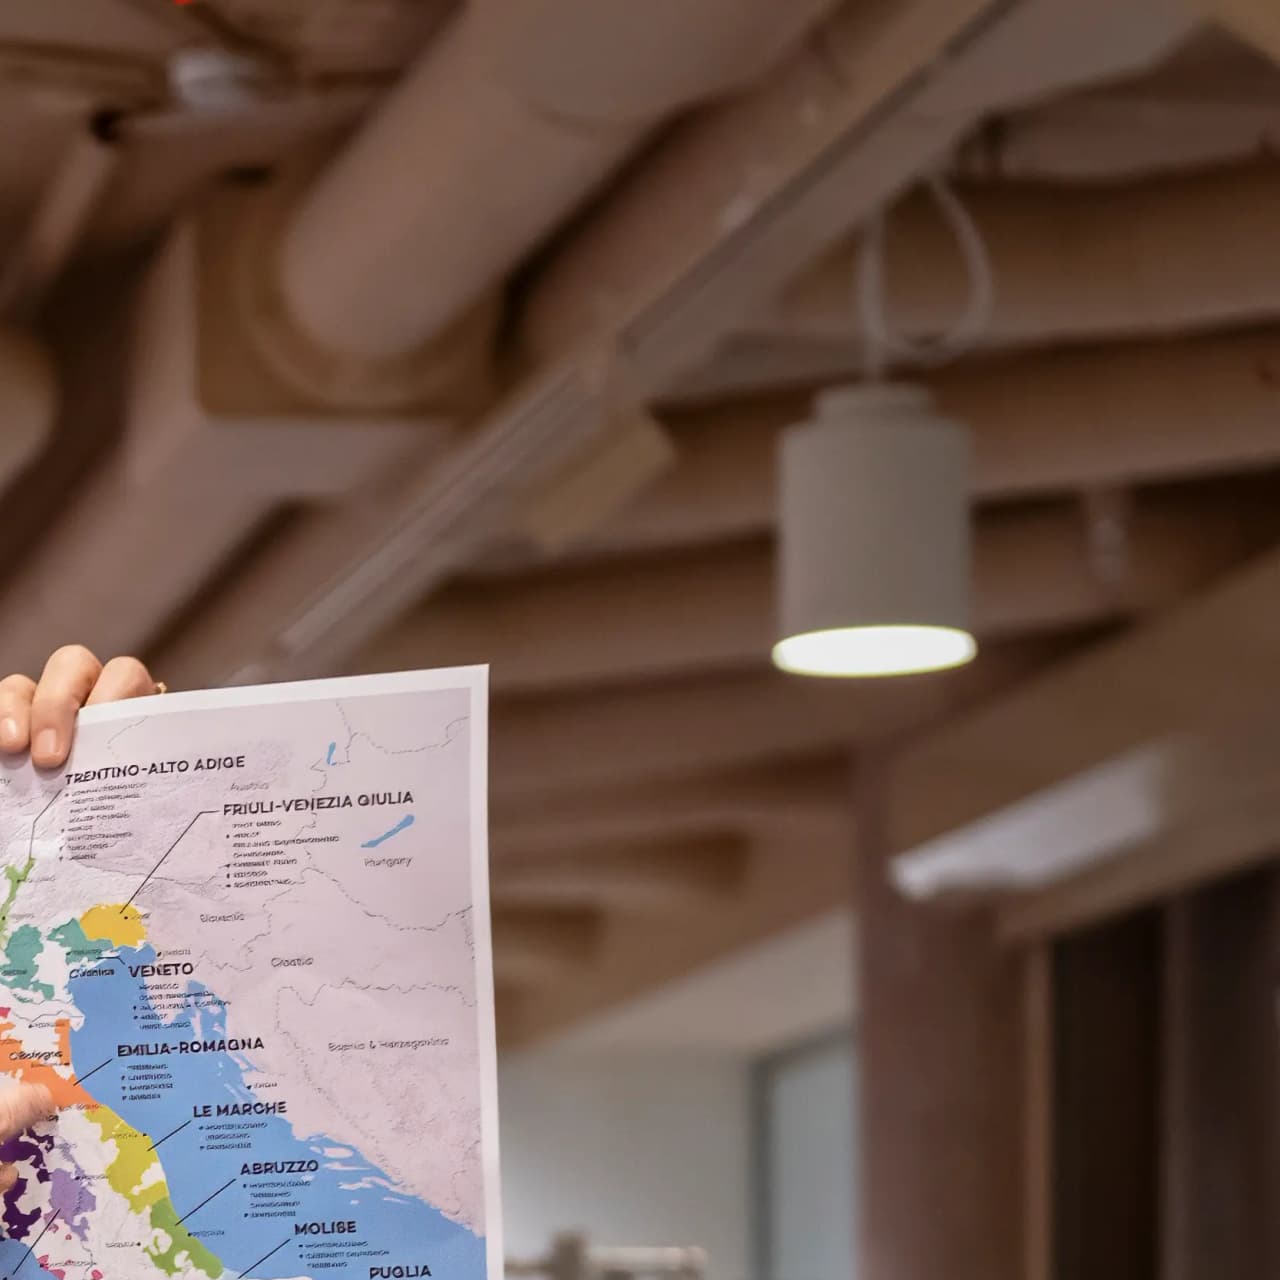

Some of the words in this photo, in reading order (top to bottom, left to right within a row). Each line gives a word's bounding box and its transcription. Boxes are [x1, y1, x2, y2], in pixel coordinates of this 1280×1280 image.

[65, 760, 189, 785] TRENTINO-ALTO
[223, 796, 354, 816] FRIULI-VENEZIA
[357, 791, 414, 807] GIULIA
[128, 962, 194, 978] VENETO
[117, 1037, 265, 1057] EMILIA-ROMAGNA
[193, 1105, 213, 1118] LE
[217, 1101, 288, 1117] MARCHE
[241, 1159, 319, 1175] ABRUZZO
[295, 1220, 357, 1235] MOLISE
[369, 1265, 432, 1279] PUGLIA
